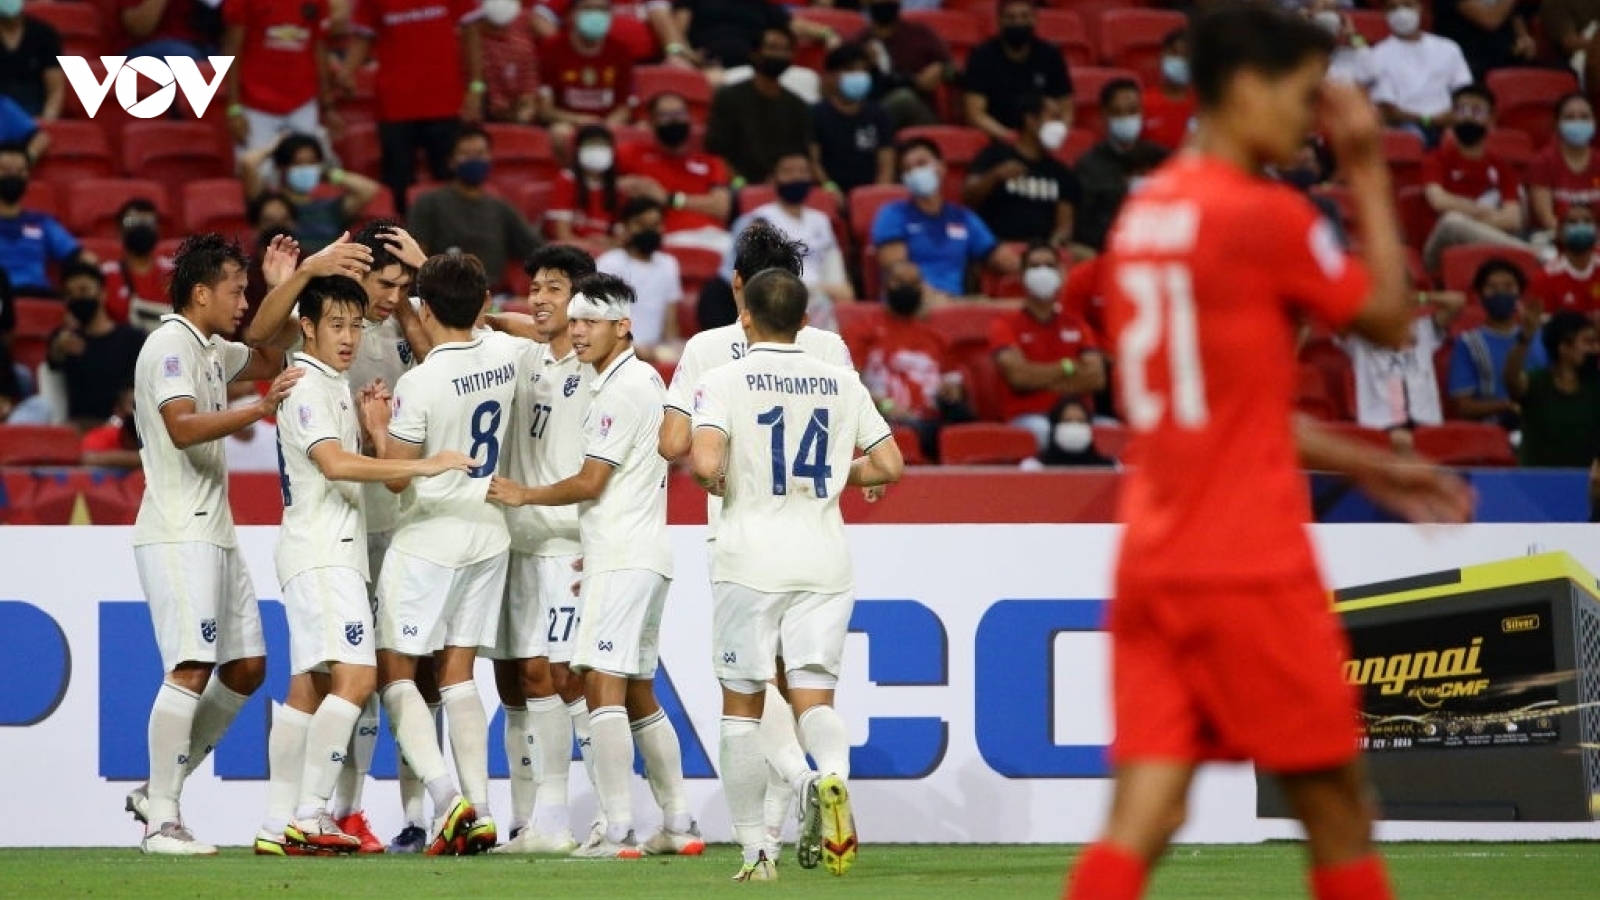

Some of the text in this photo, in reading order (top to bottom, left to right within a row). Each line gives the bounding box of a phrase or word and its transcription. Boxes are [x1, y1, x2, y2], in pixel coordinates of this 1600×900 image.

[1118, 262, 1208, 430] 21
[452, 363, 515, 395] THITIPHAN
[747, 374, 838, 396] PATHOMPON
[467, 400, 502, 478] 8
[530, 403, 552, 439] 27
[757, 406, 832, 498] 14
[547, 607, 576, 642] 27
